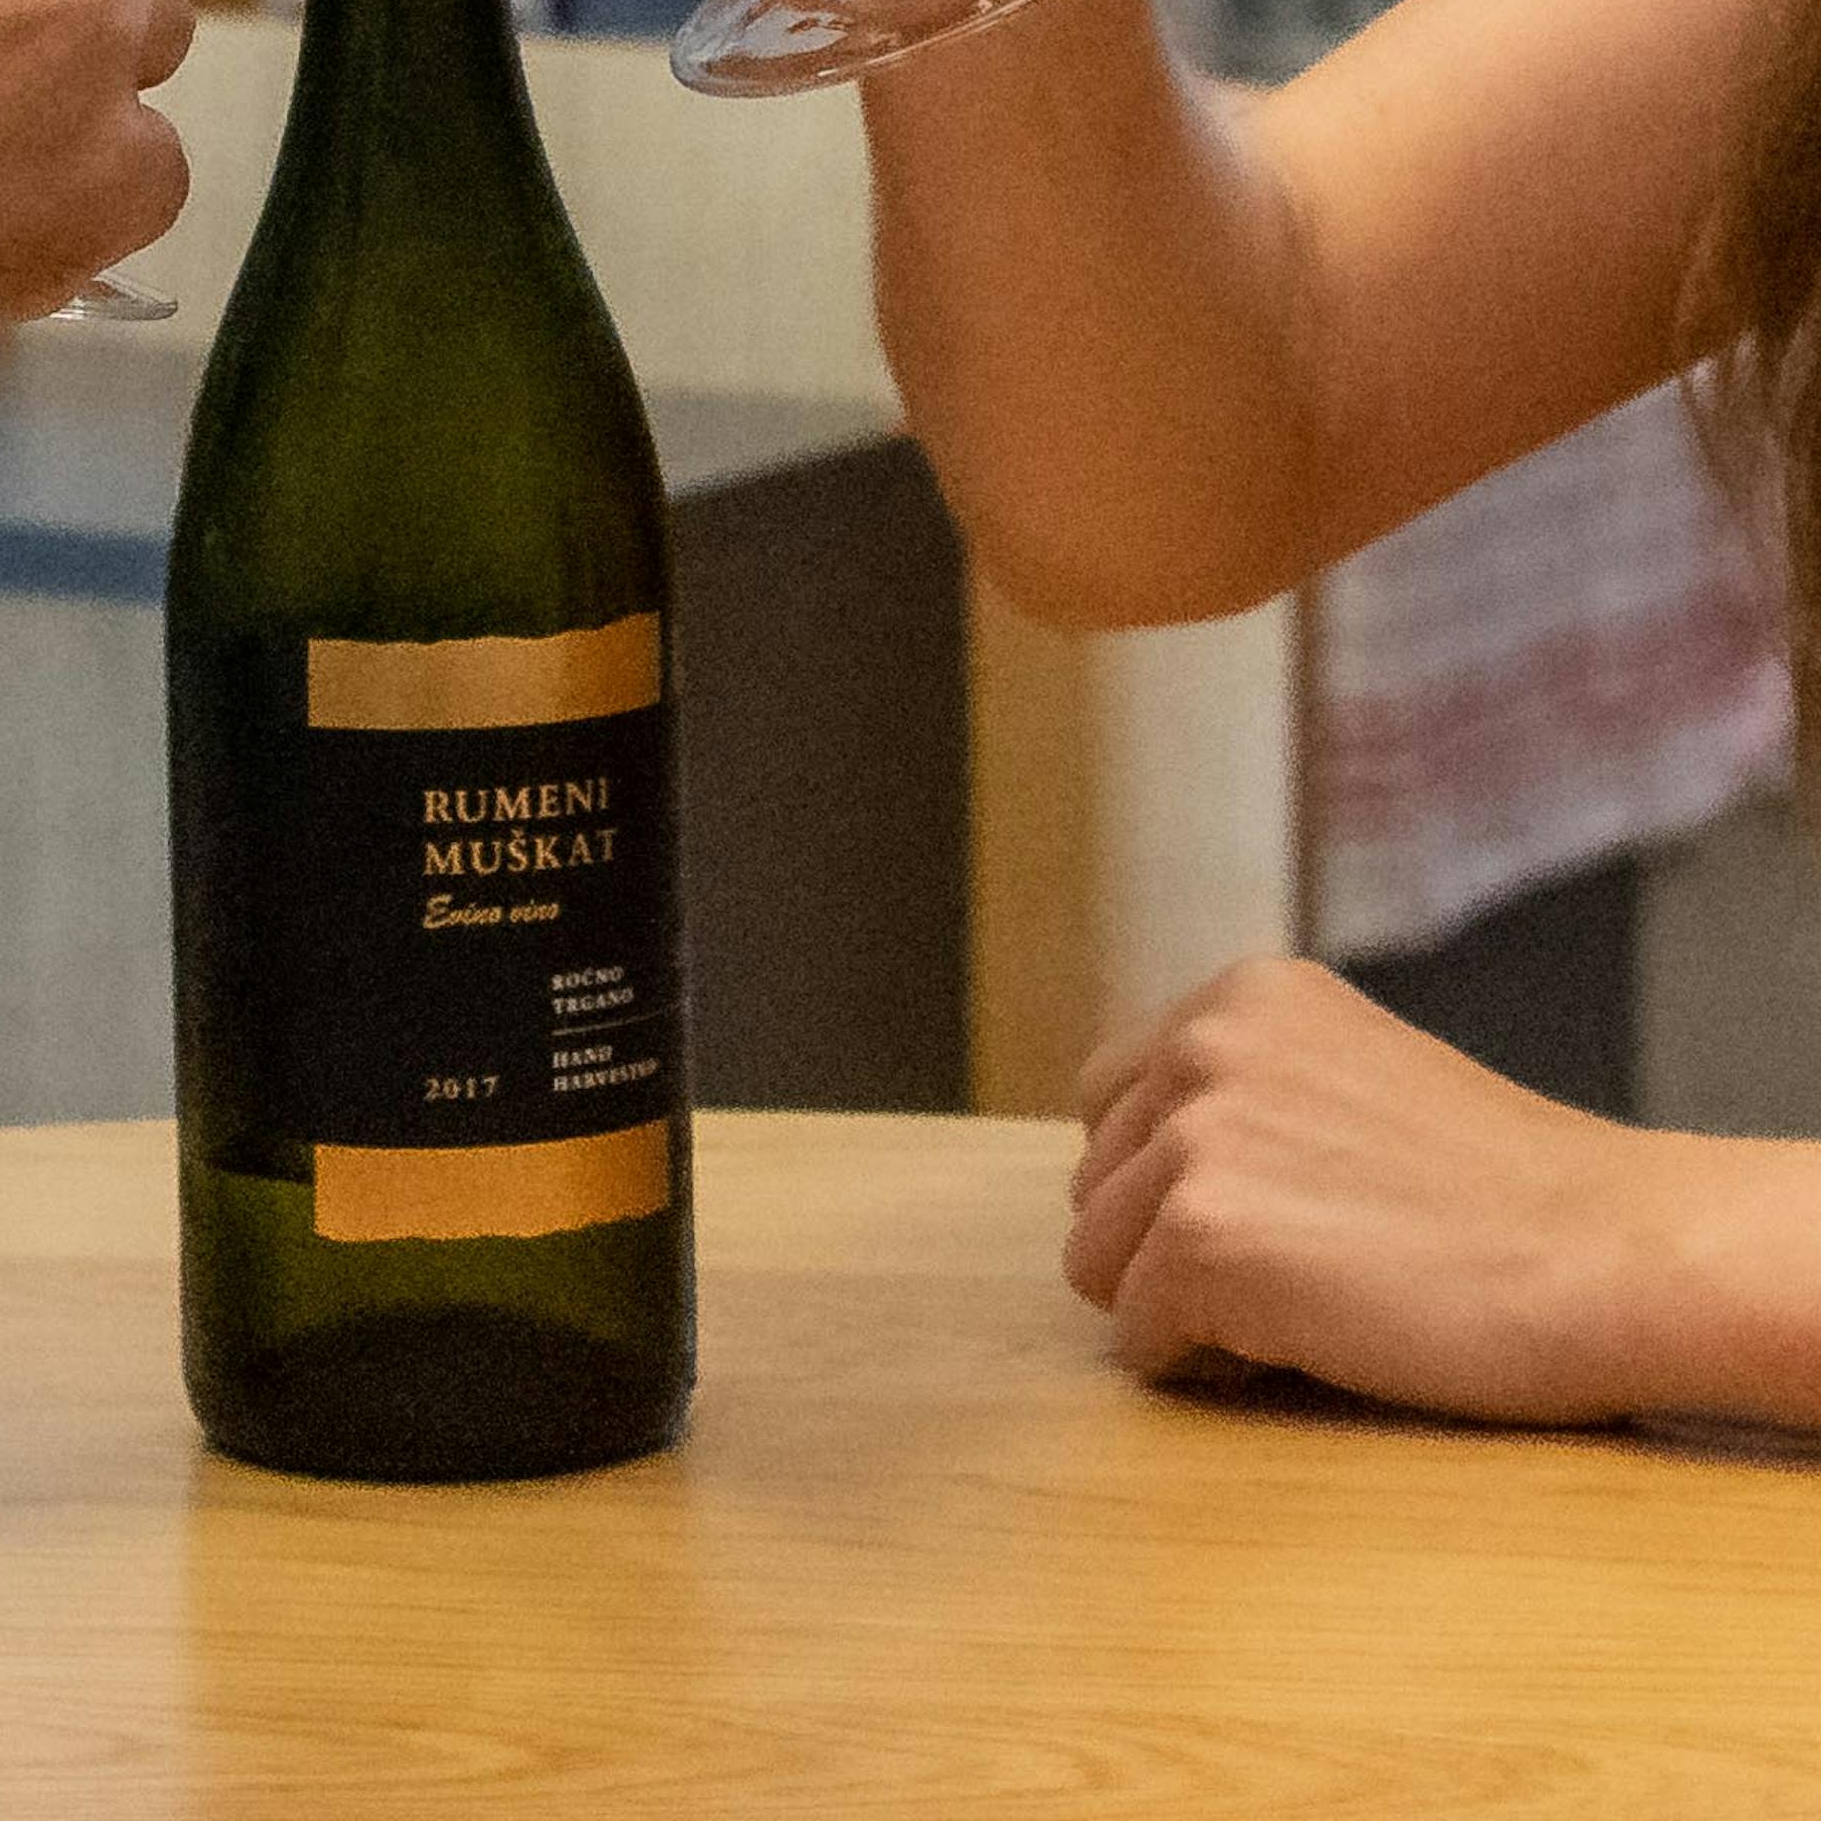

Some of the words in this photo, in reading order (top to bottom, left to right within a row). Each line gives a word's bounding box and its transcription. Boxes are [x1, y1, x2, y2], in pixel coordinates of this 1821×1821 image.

[423, 777, 608, 823] RUMENI
[422, 828, 618, 876] MUŠKAT
[423, 1074, 500, 1101] 2017
